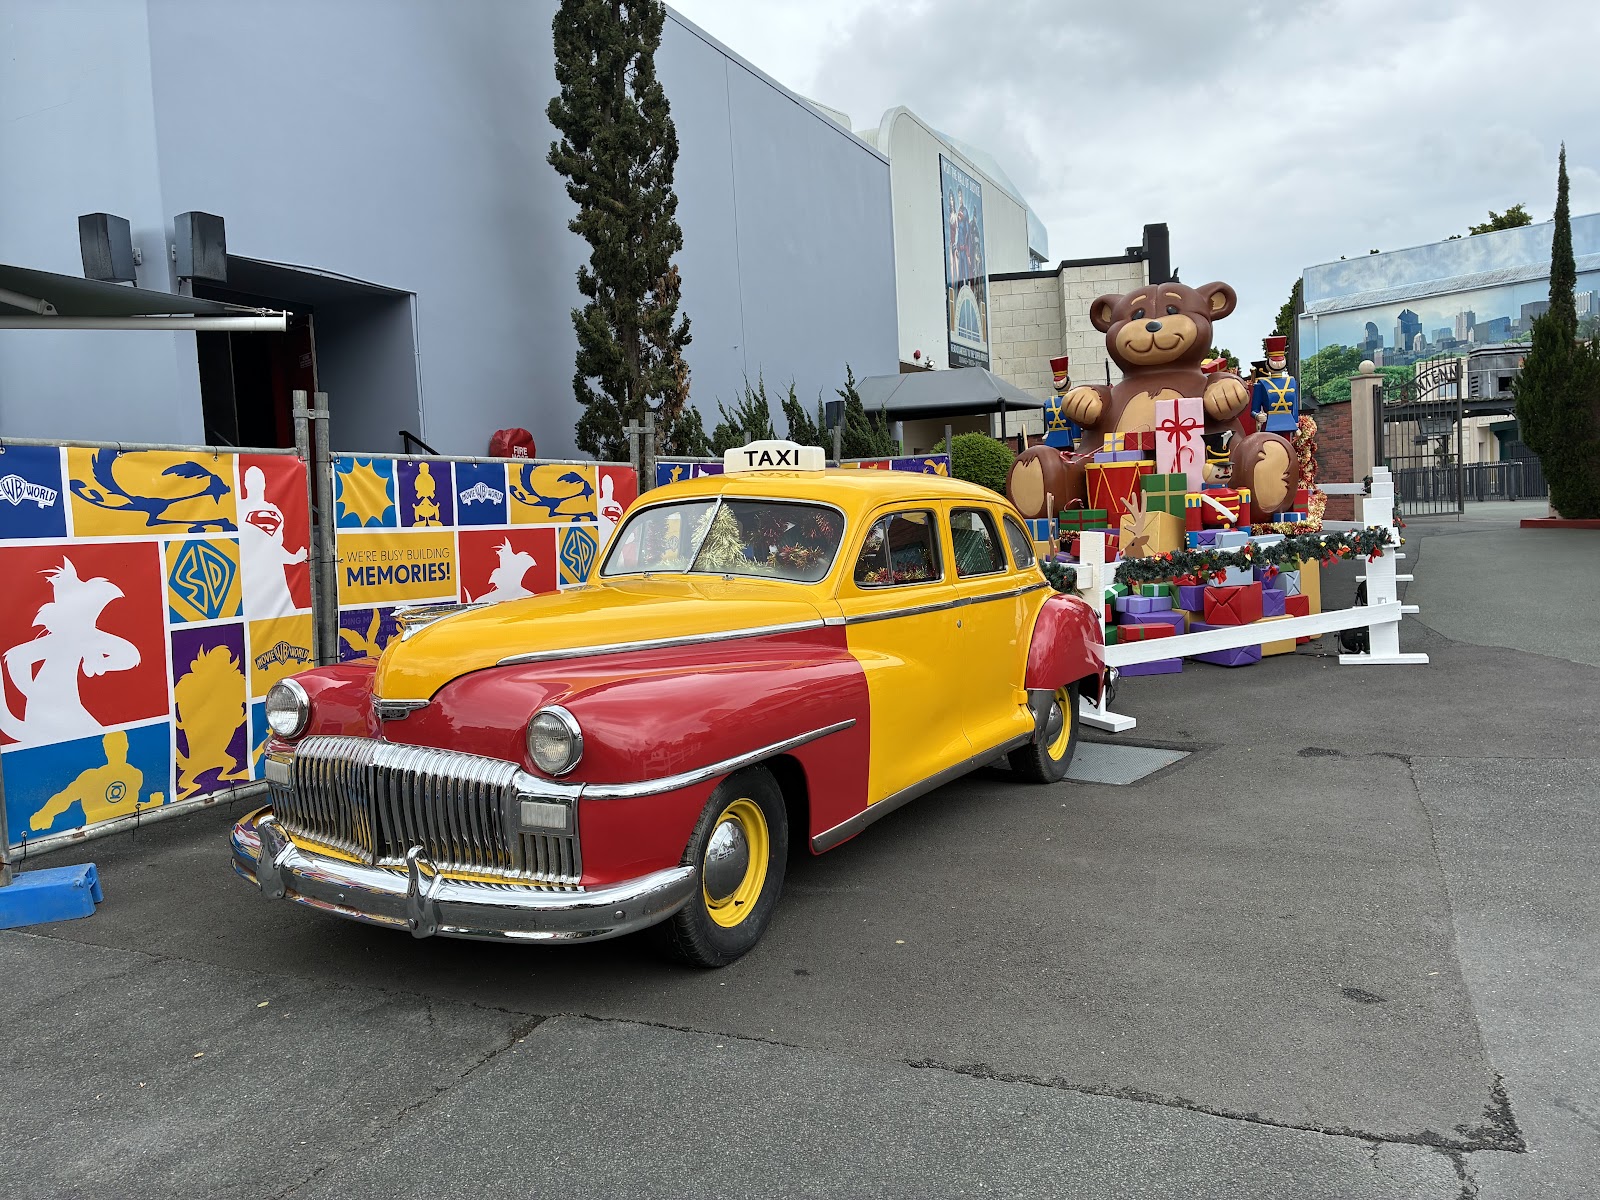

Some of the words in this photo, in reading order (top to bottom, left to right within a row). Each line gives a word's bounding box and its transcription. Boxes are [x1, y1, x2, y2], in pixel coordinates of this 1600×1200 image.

[513, 445, 528, 455] FIRE
[743, 449, 799, 467] TAXI
[2, 478, 23, 501] WB
[26, 485, 56, 502] WORLD
[461, 489, 475, 502] MOVIE
[487, 489, 502, 501] WORLD
[346, 550, 377, 563] WE'RE
[380, 549, 404, 561] BUSY
[407, 547, 450, 561] BUILDING
[346, 562, 450, 587] MEMORIES!
[257, 650, 276, 669] MOVIE
[274, 643, 290, 663] WB
[290, 647, 309, 659] WORLD
